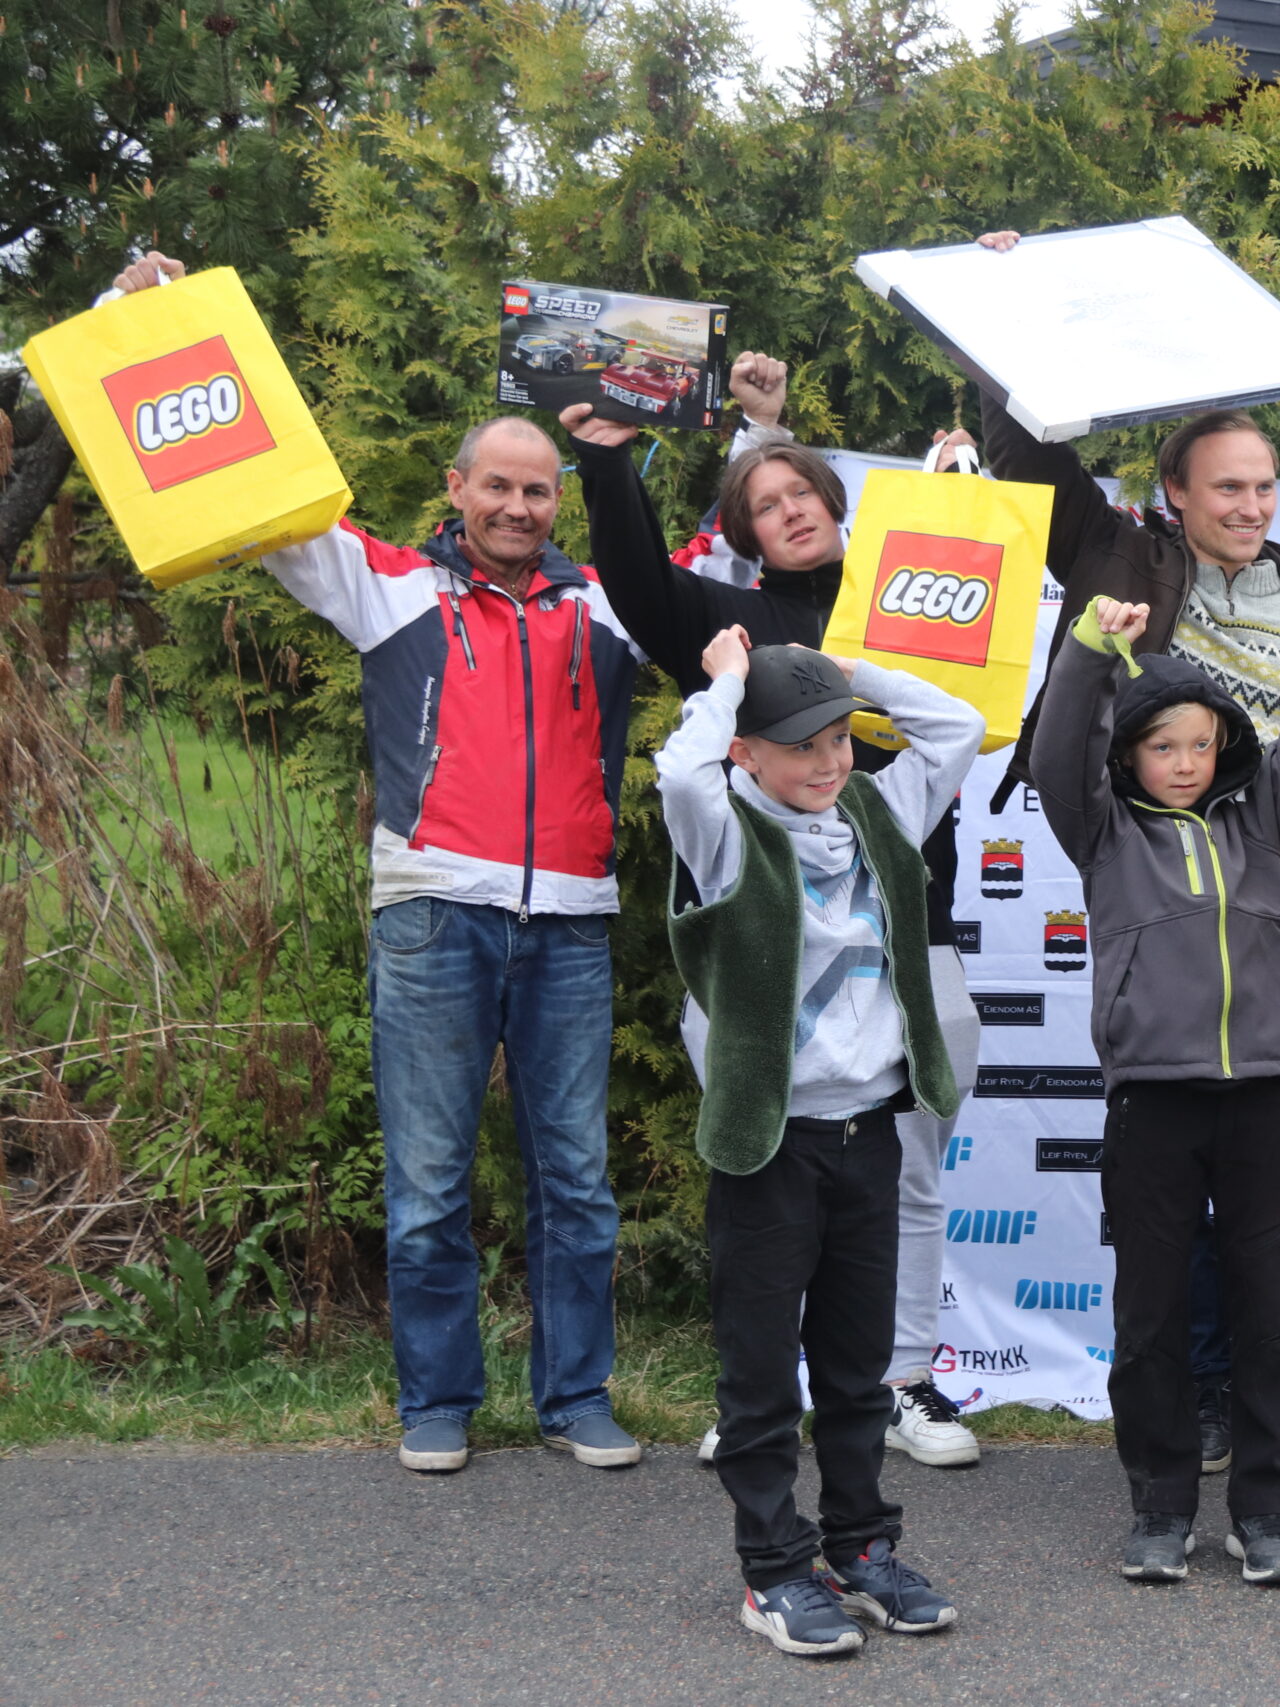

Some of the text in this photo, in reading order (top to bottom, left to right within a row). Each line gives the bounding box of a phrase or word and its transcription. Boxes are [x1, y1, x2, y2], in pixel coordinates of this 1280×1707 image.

[506, 295, 601, 314] LEGO SPEED
[501, 370, 514, 381] 8+
[138, 375, 240, 452] LEGO
[880, 569, 989, 624] LEGO
[963, 933, 977, 941] AS
[983, 1005, 1040, 1014] EIENDOM AS
[979, 1077, 1104, 1087] LEIF RYEN EIENDOM AS
[1042, 1151, 1087, 1160] LEIF RYEN
[959, 1344, 1028, 1370] TRYKK
